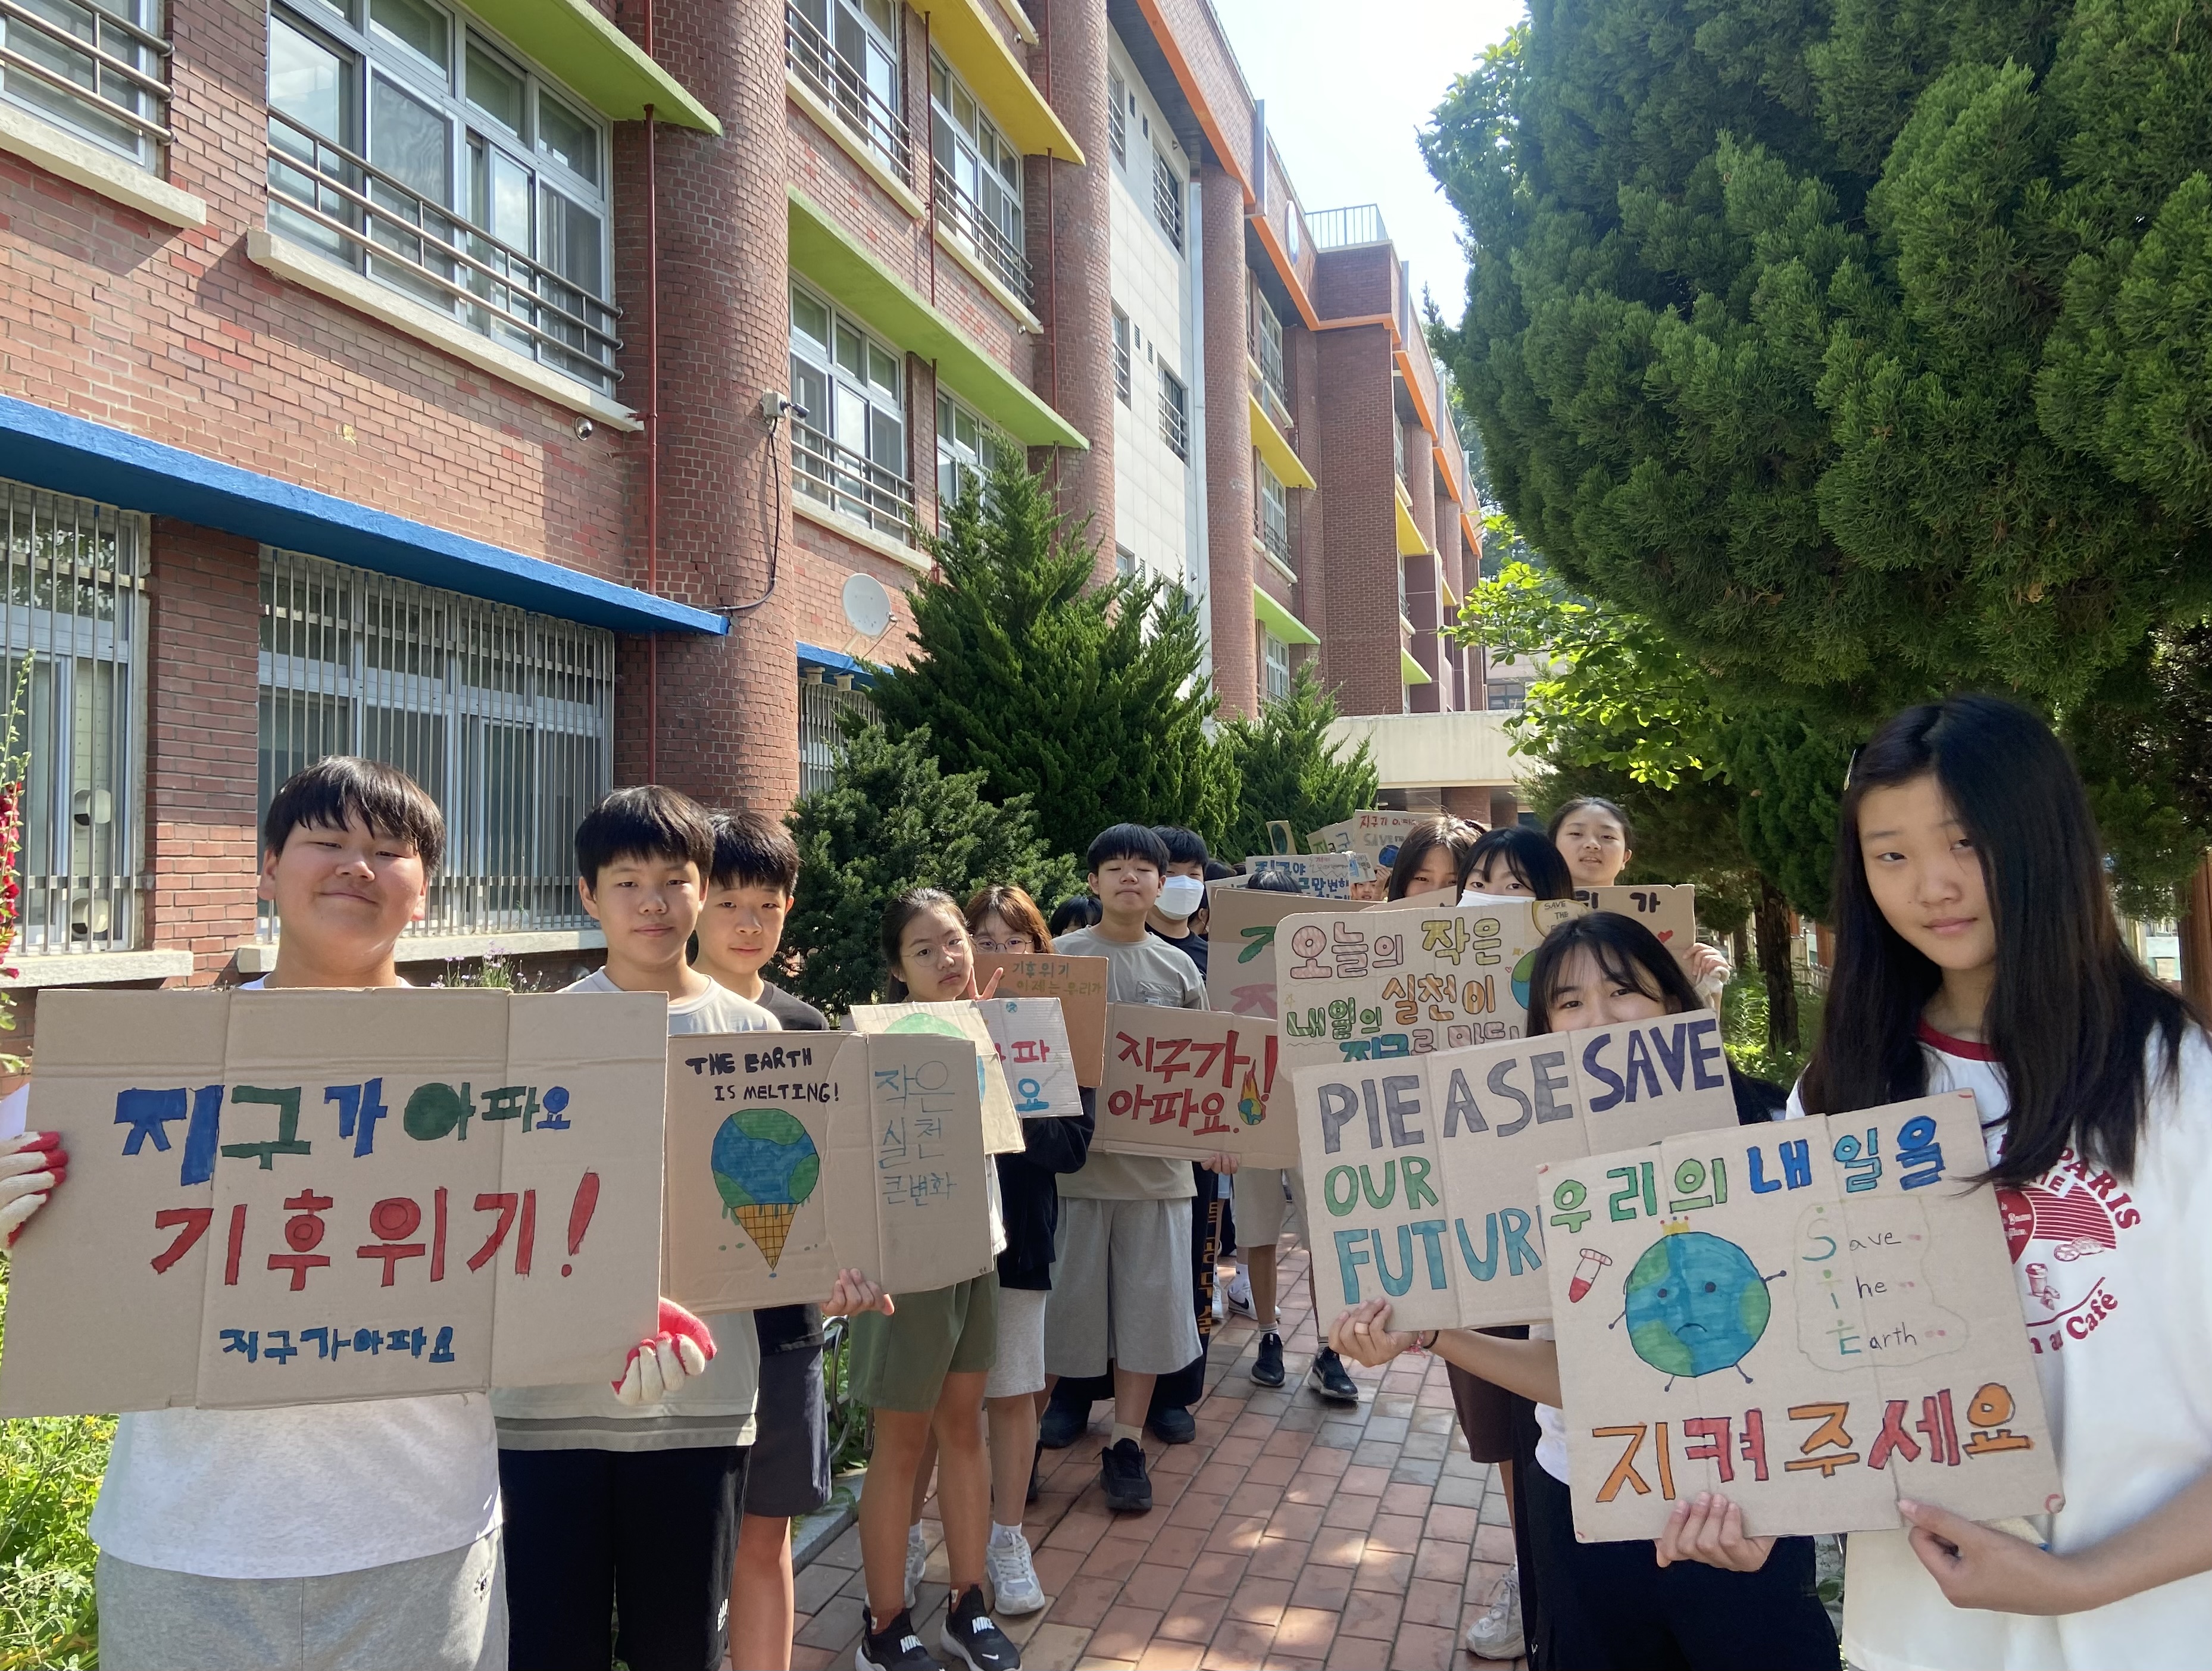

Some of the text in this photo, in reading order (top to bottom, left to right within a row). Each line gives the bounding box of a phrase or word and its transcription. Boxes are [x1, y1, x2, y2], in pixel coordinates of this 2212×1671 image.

[1544, 901, 1566, 910] SAVE
[1554, 911, 1569, 920] THE
[1290, 922, 1404, 979] 오늘의
[1421, 917, 1501, 966] 작은
[1286, 997, 1382, 1040] 내일의
[1382, 973, 1495, 1025] 실천이
[685, 1047, 813, 1076] THE EARTH
[1582, 1019, 1725, 1113] SAVE
[714, 1082, 839, 1102] IS MELTING!
[1324, 1155, 1439, 1217] OUR
[1550, 1115, 1945, 1234] 우리의 내일을
[1333, 1205, 1546, 1305] FUTUR
[2066, 1289, 2118, 1340] Café
